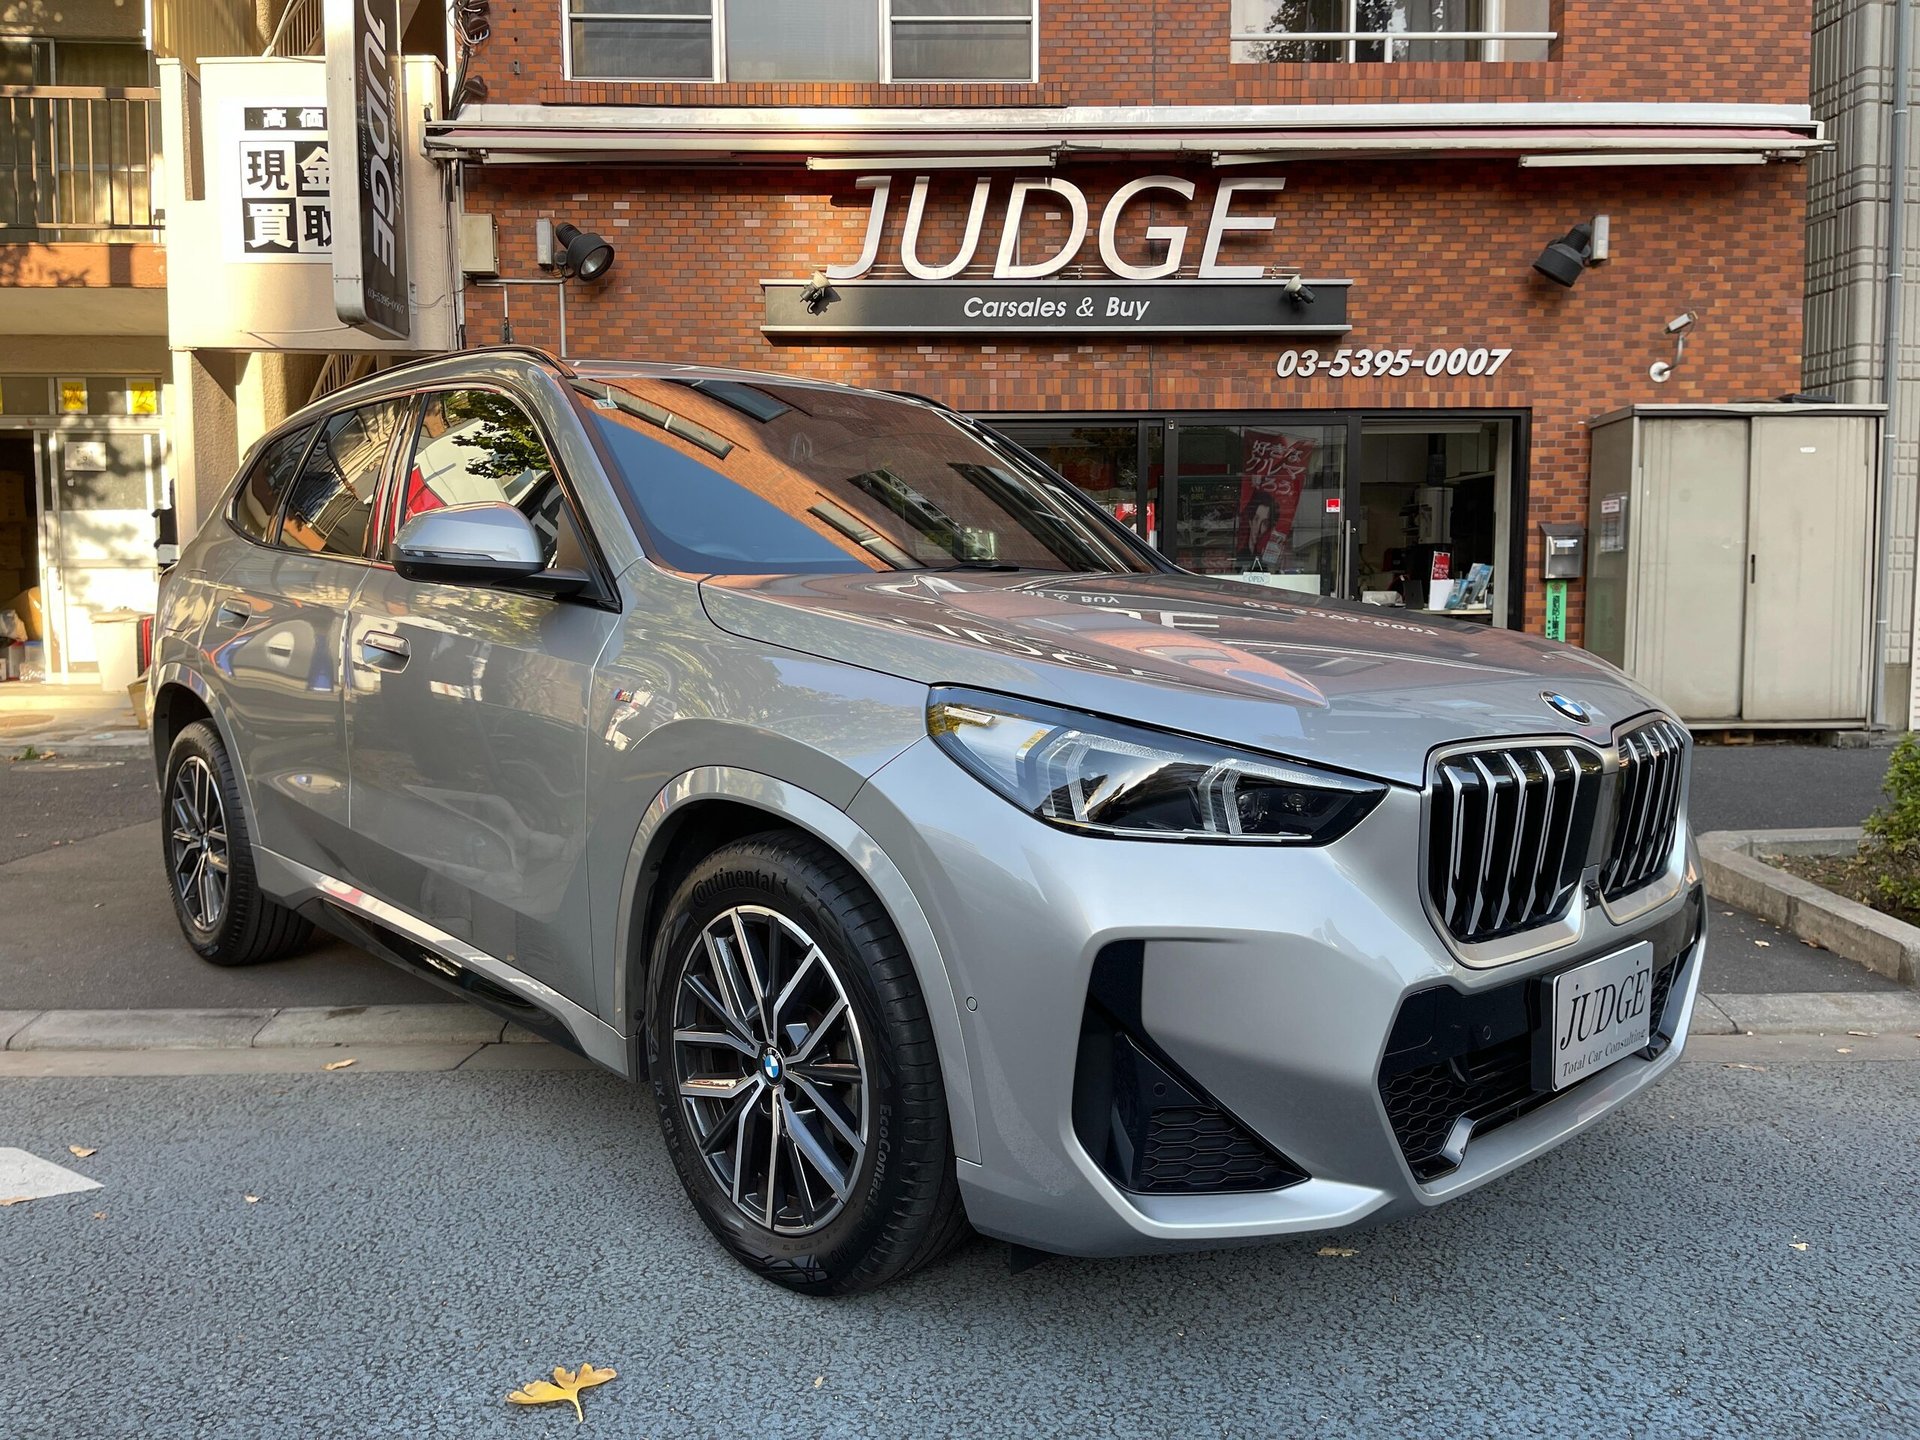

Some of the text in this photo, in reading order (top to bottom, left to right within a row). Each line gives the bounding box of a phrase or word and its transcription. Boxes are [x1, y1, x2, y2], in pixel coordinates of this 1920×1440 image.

[261, 108, 325, 129] 高価
[363, 0, 396, 278] JUDGE
[246, 146, 330, 191] 現金
[388, 76, 402, 216] Super Dealer
[245, 203, 332, 249] 買取
[826, 175, 1286, 281] JUDGE
[963, 297, 1151, 321] Carsales & Buy
[1276, 347, 1513, 378] 03-5395-0007
[1560, 967, 1650, 1050] JUDGE
[1562, 1028, 1647, 1078] Total Car Consulting
